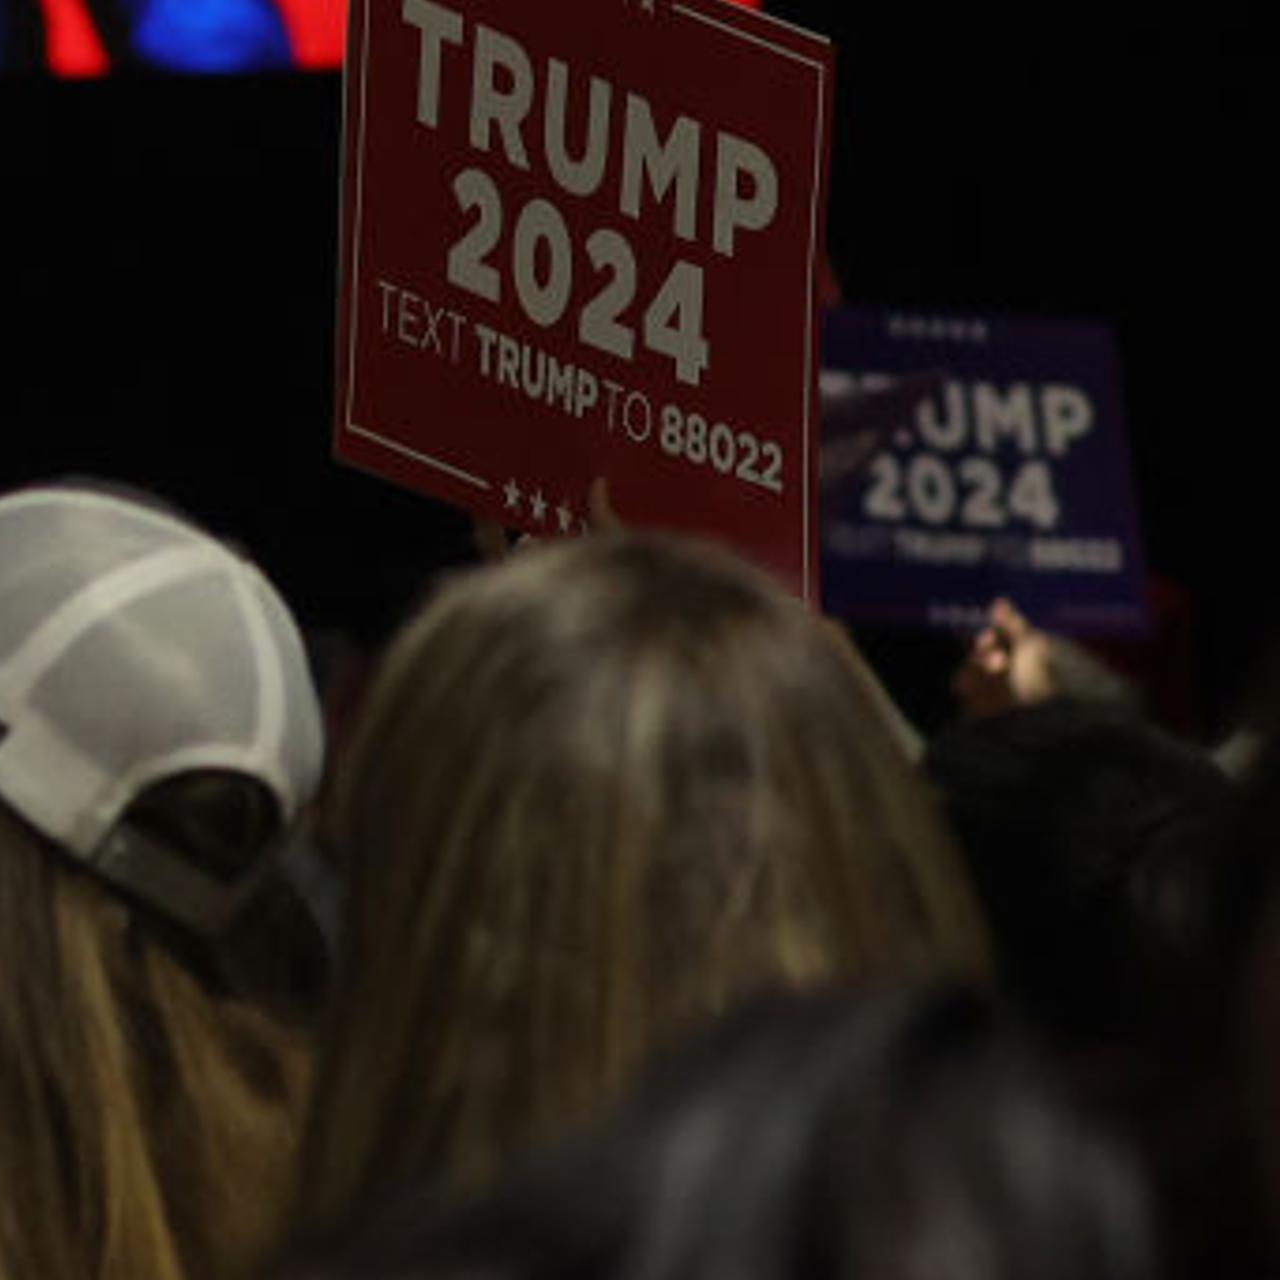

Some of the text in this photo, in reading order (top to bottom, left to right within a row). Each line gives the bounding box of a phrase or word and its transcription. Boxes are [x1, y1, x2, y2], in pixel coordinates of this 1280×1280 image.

[447, 168, 709, 387] 2024
[378, 280, 785, 495] TEXT TRUMP TO 88022
[818, 371, 1095, 459] UMP
[863, 452, 1061, 529] 2024
